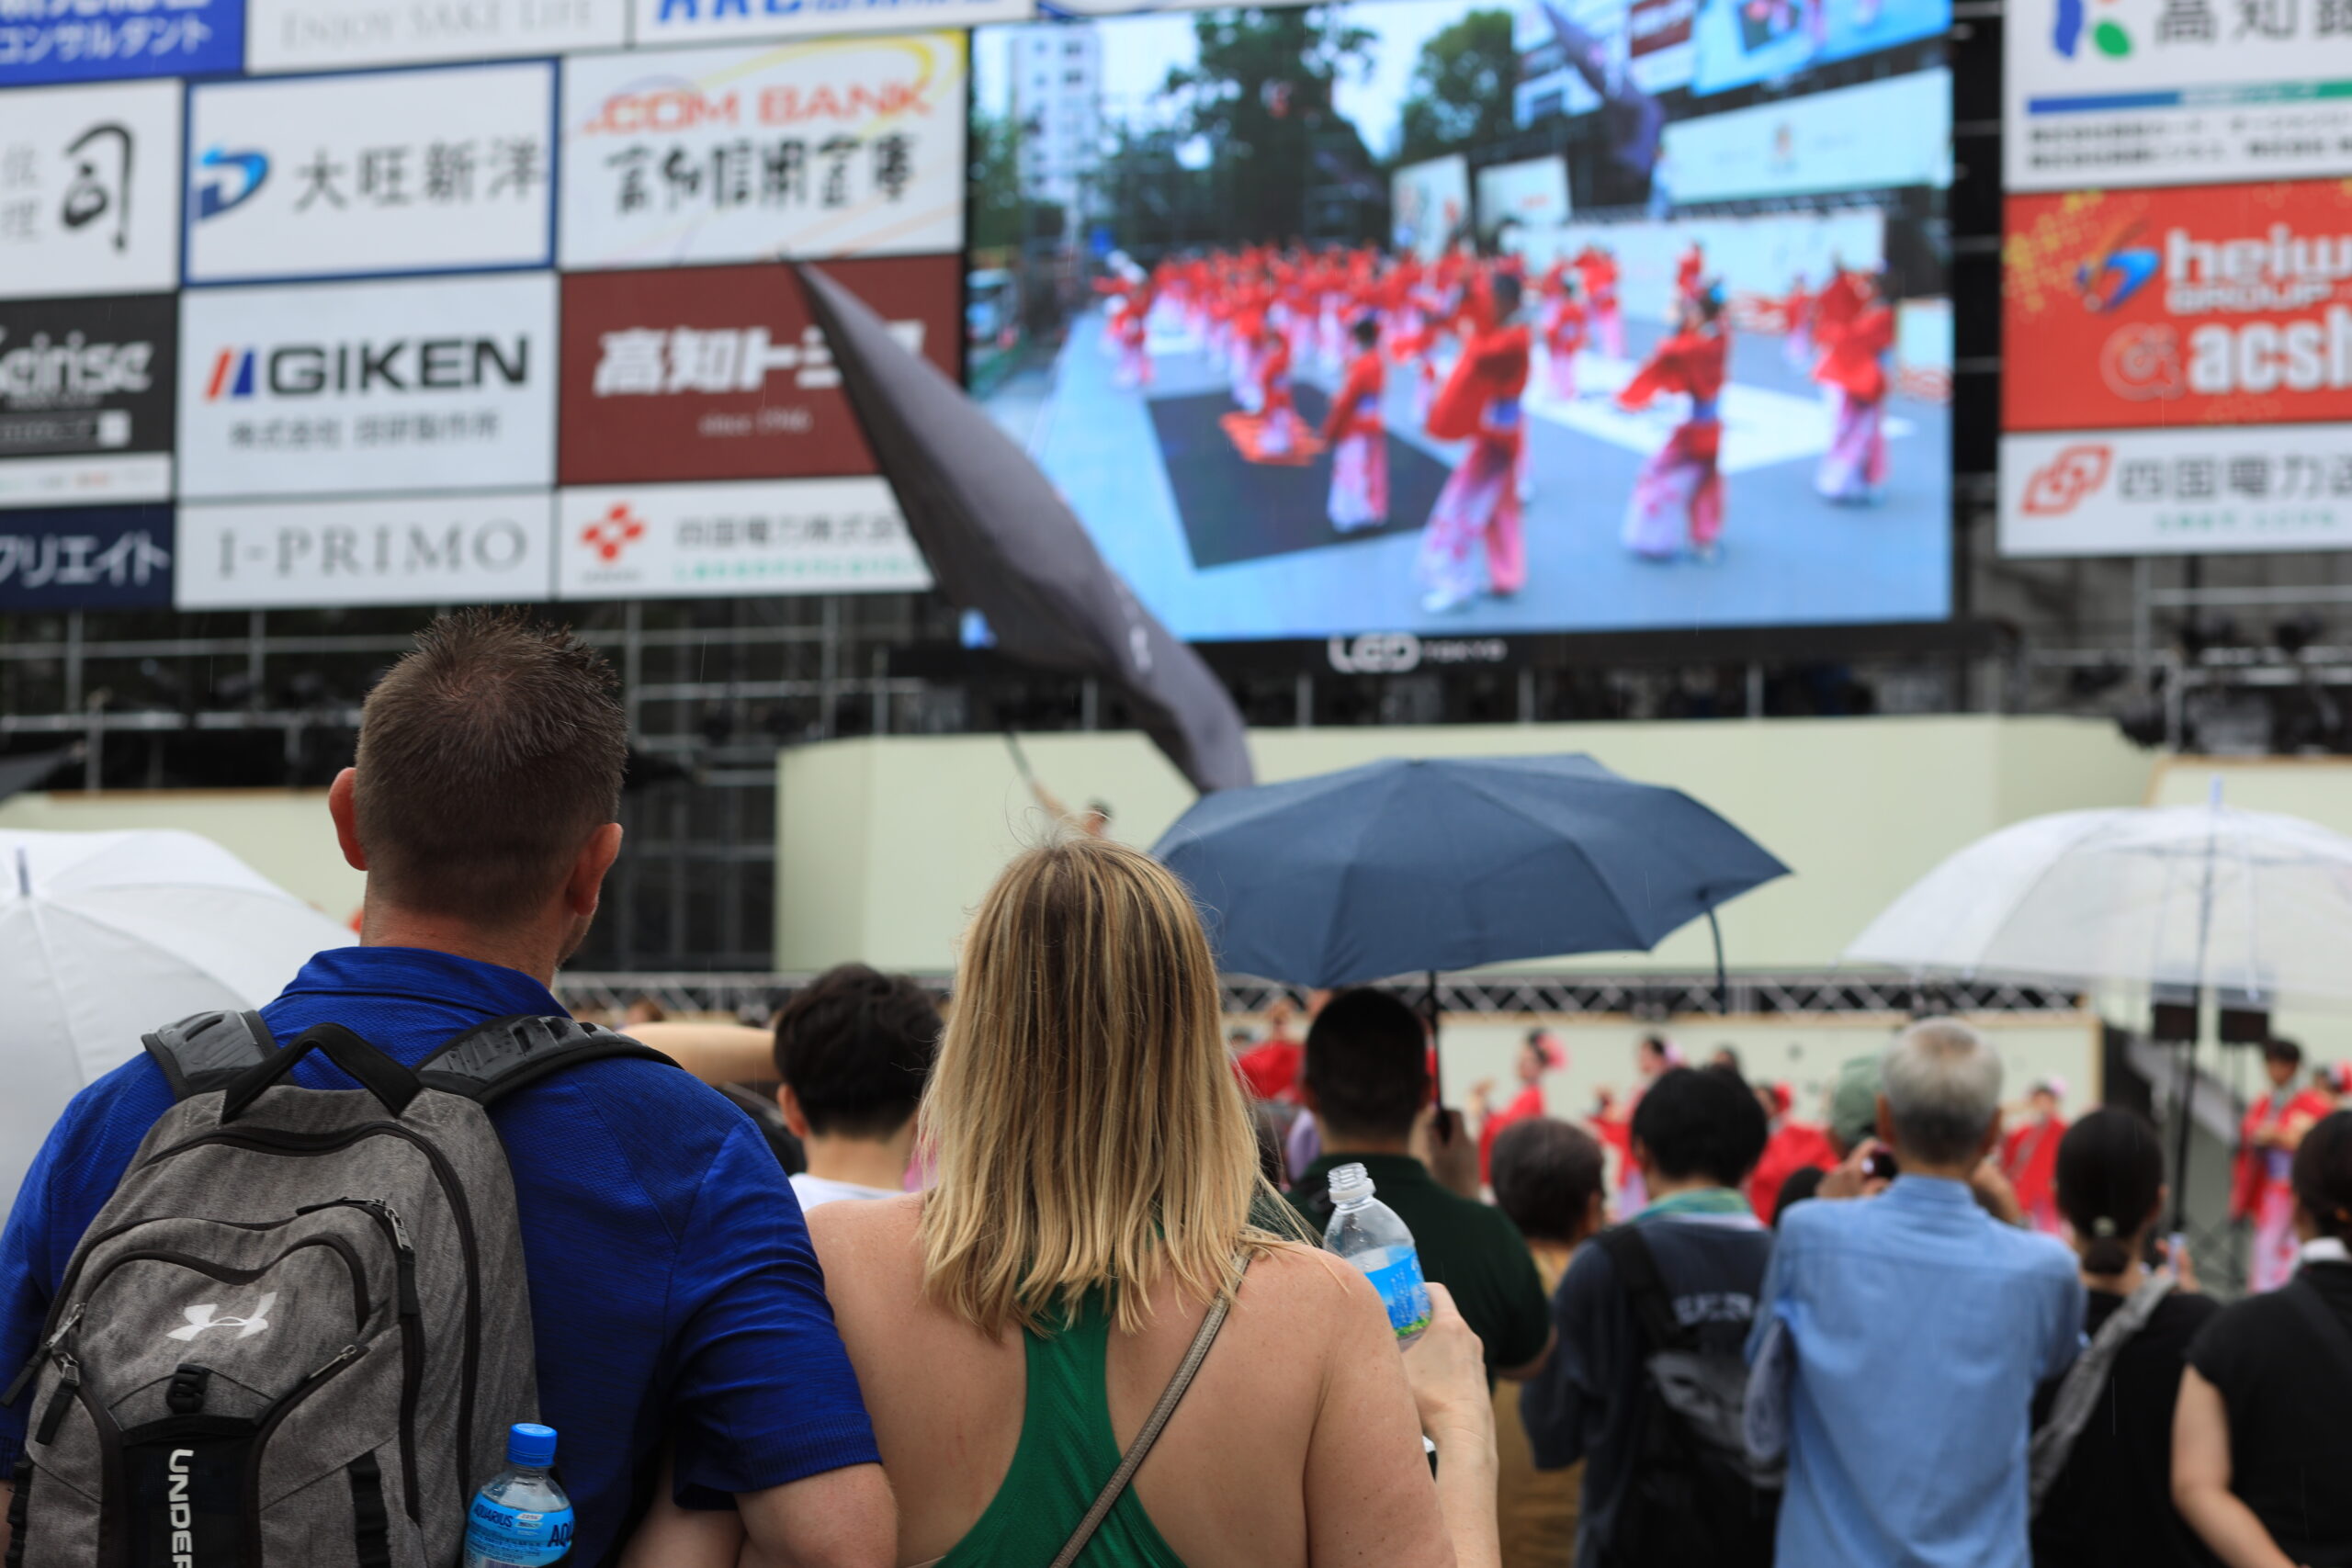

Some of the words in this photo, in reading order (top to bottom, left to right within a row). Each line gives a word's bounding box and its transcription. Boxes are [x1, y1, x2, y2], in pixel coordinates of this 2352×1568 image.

[292, 138, 544, 212] 大旺新洋
[268, 335, 528, 395] GIKEN
[219, 518, 526, 581] I-PRIMO
